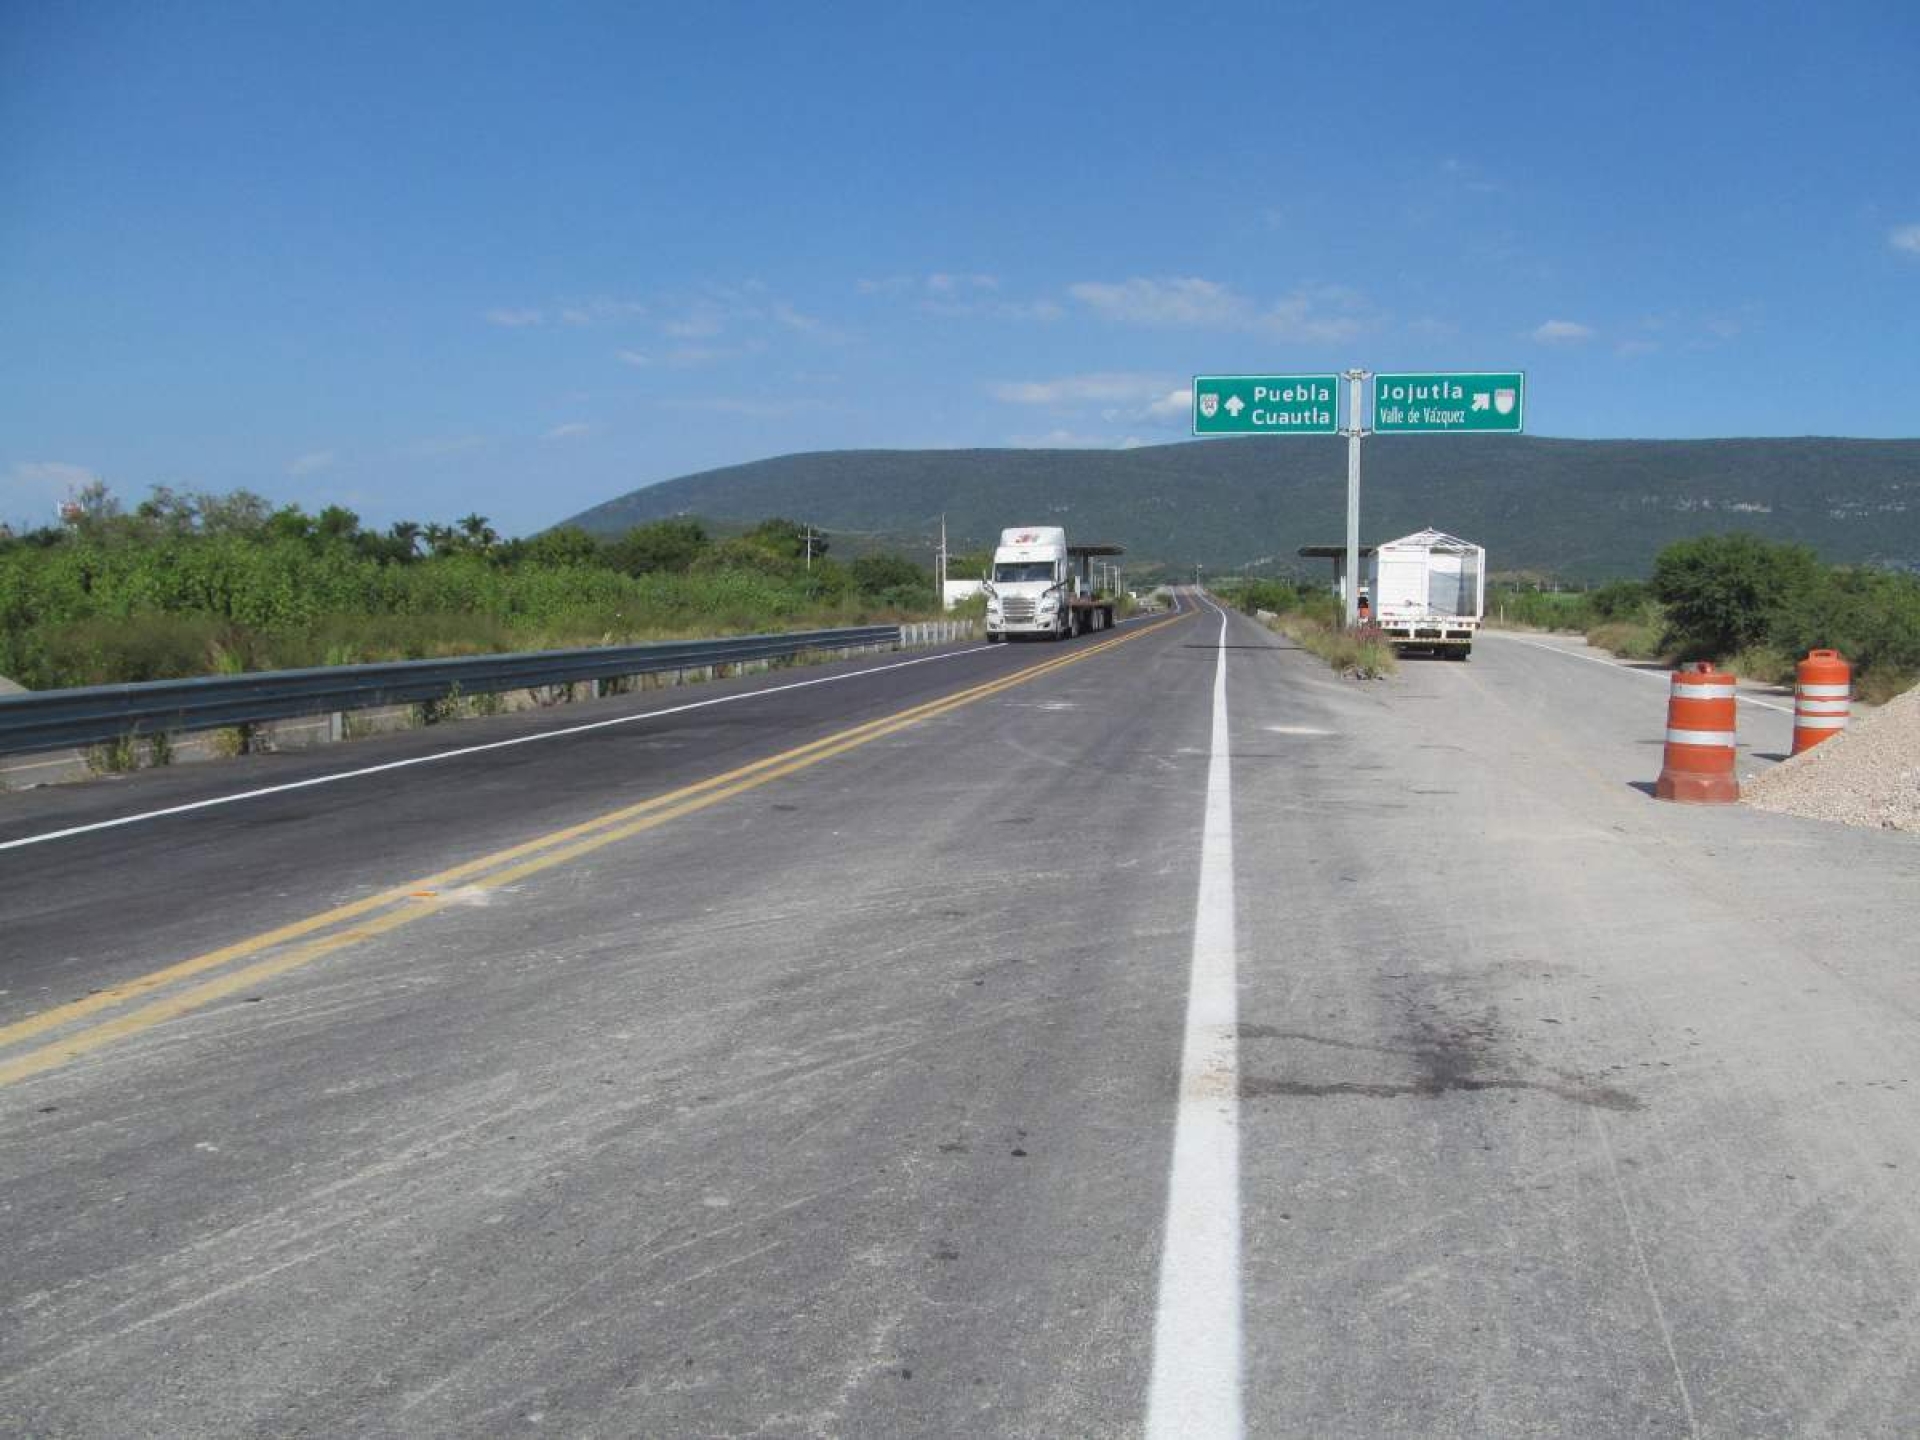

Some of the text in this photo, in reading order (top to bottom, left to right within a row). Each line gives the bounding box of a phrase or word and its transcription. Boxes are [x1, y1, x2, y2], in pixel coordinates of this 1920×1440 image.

[1254, 383, 1329, 403] Puebla
[1381, 382, 1463, 403] Jojutla
[1252, 407, 1329, 424] Cuautla
[1380, 406, 1465, 429] Valle de Vázquez
